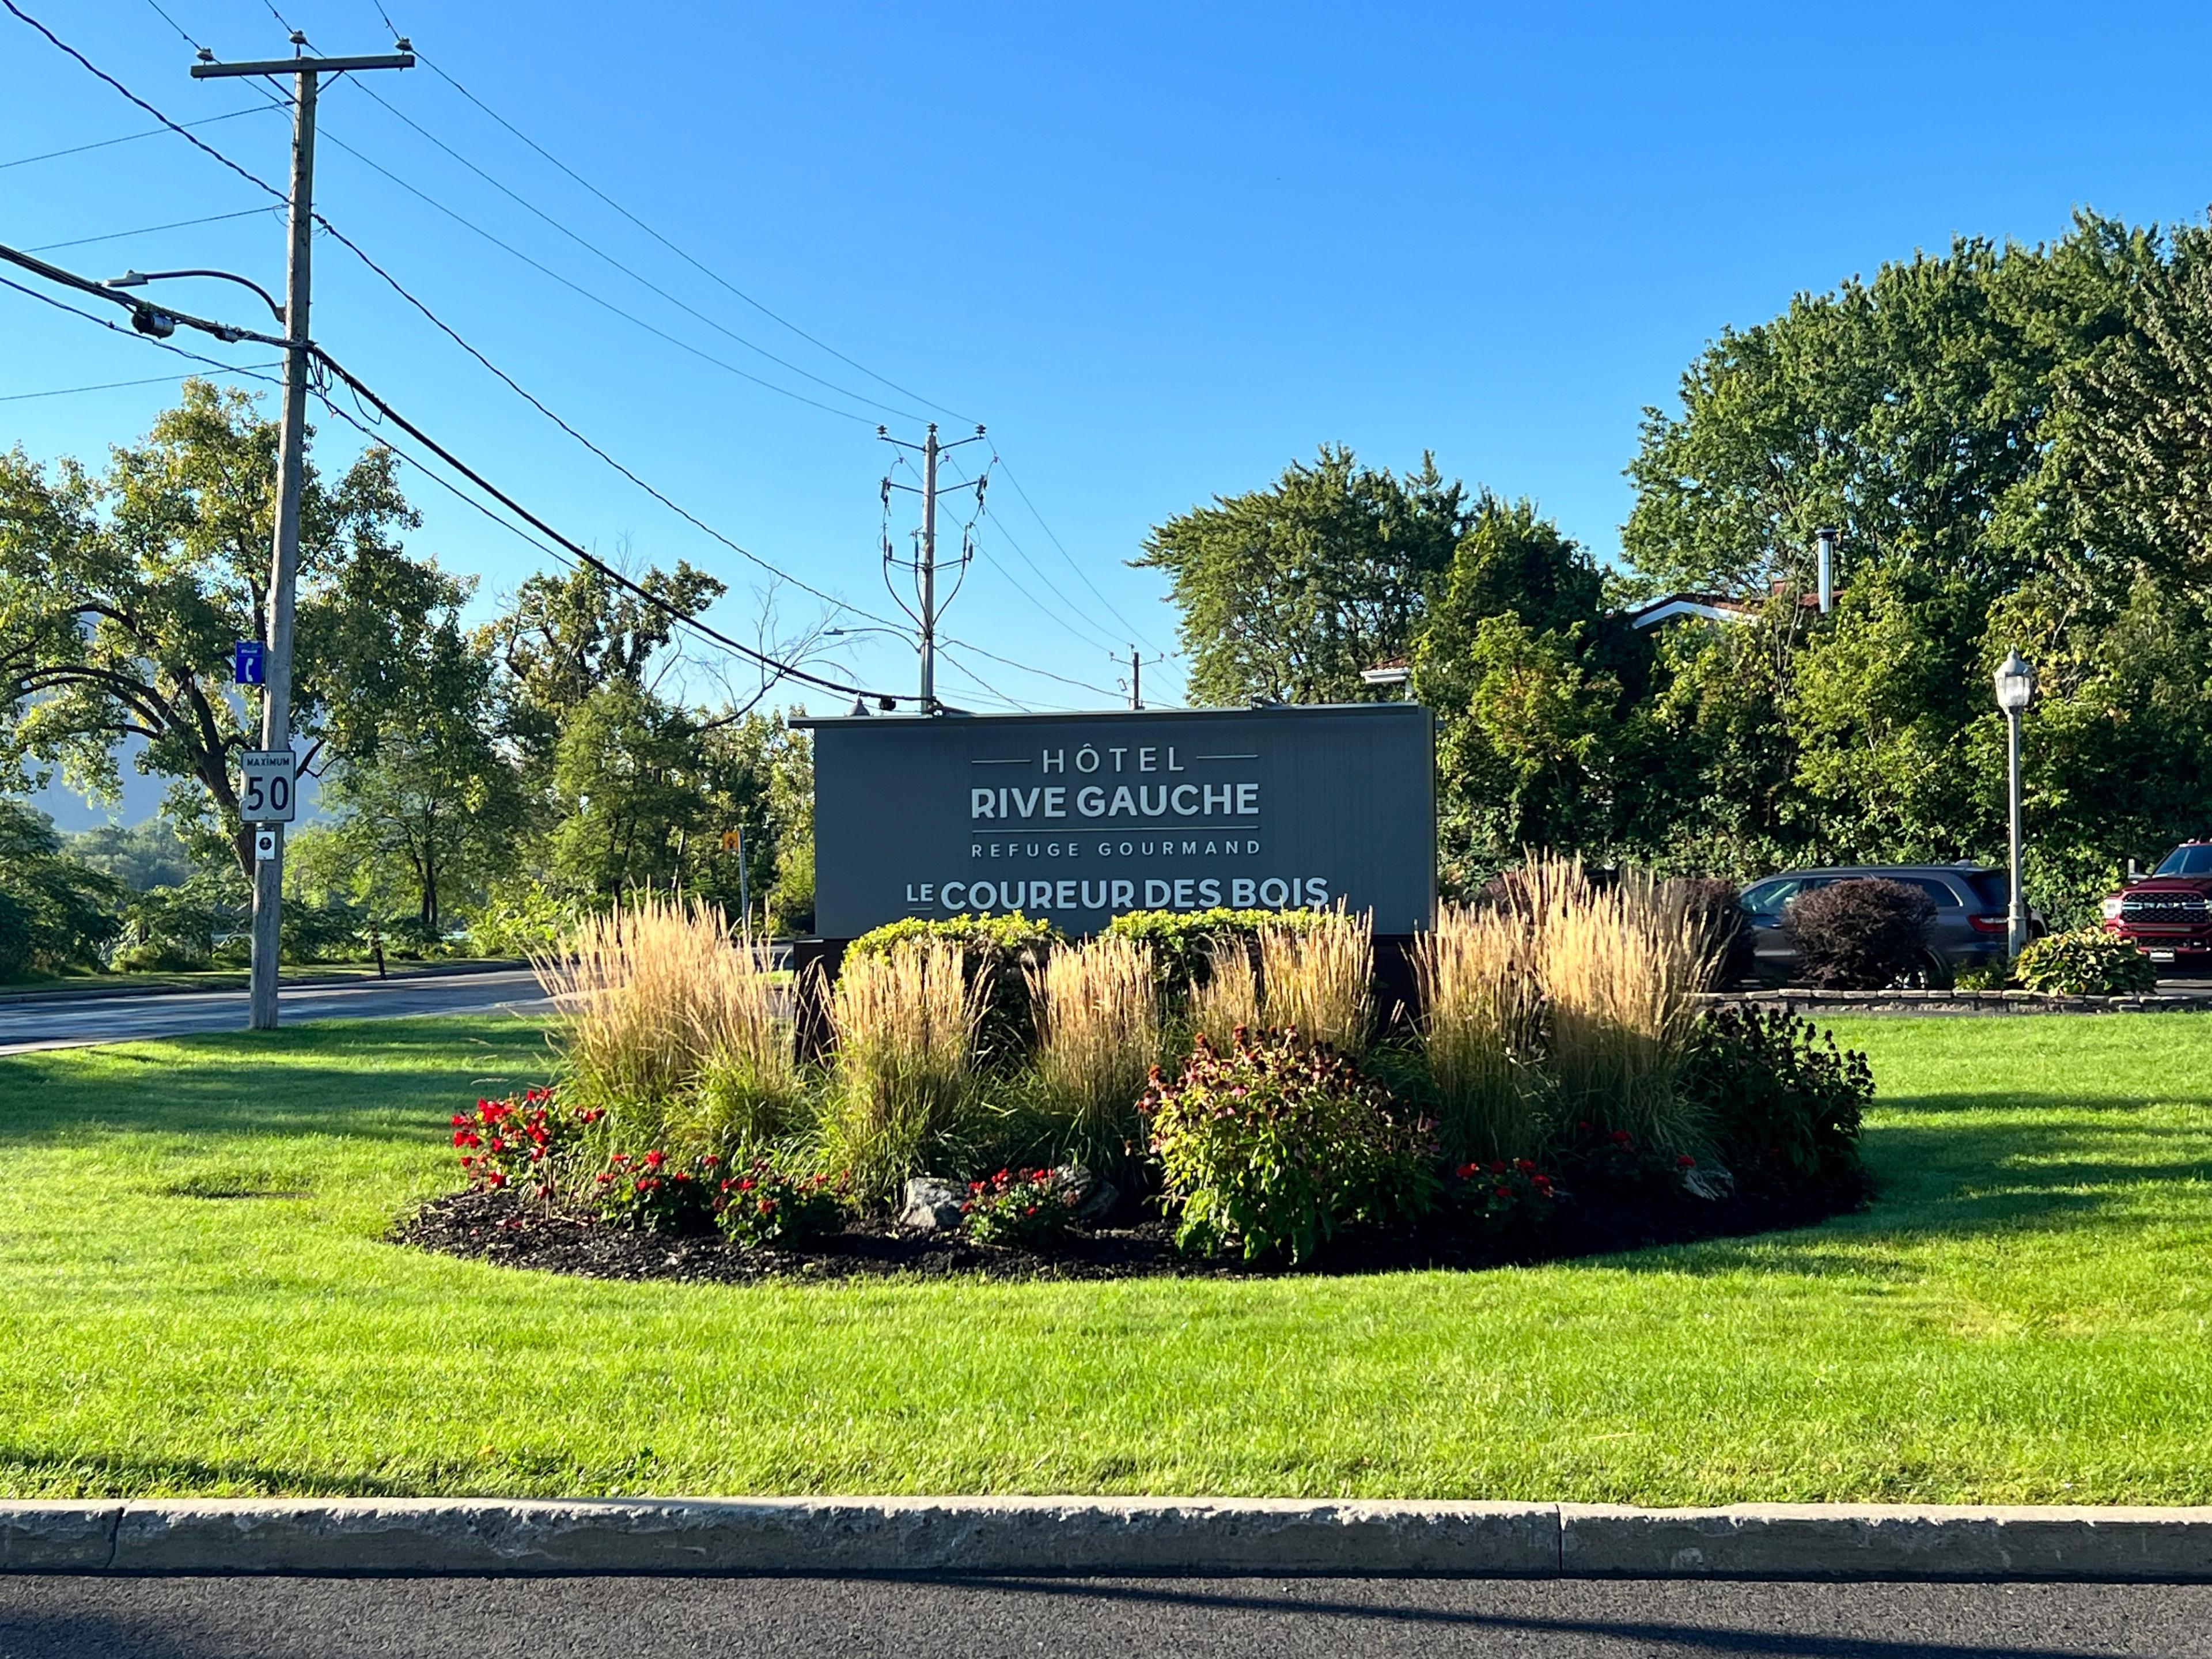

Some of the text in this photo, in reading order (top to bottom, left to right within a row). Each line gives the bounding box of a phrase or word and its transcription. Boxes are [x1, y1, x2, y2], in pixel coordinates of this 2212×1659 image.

[247, 757, 290, 767] MAXIMUM
[1043, 743, 1184, 773] HÔTEL
[247, 776, 289, 811] 50
[971, 783, 1259, 819] RIVE GAUCHE
[971, 840, 1260, 857] REFUGE GOURMAND
[906, 877, 1329, 910] LE COUREUR DES BOIS
